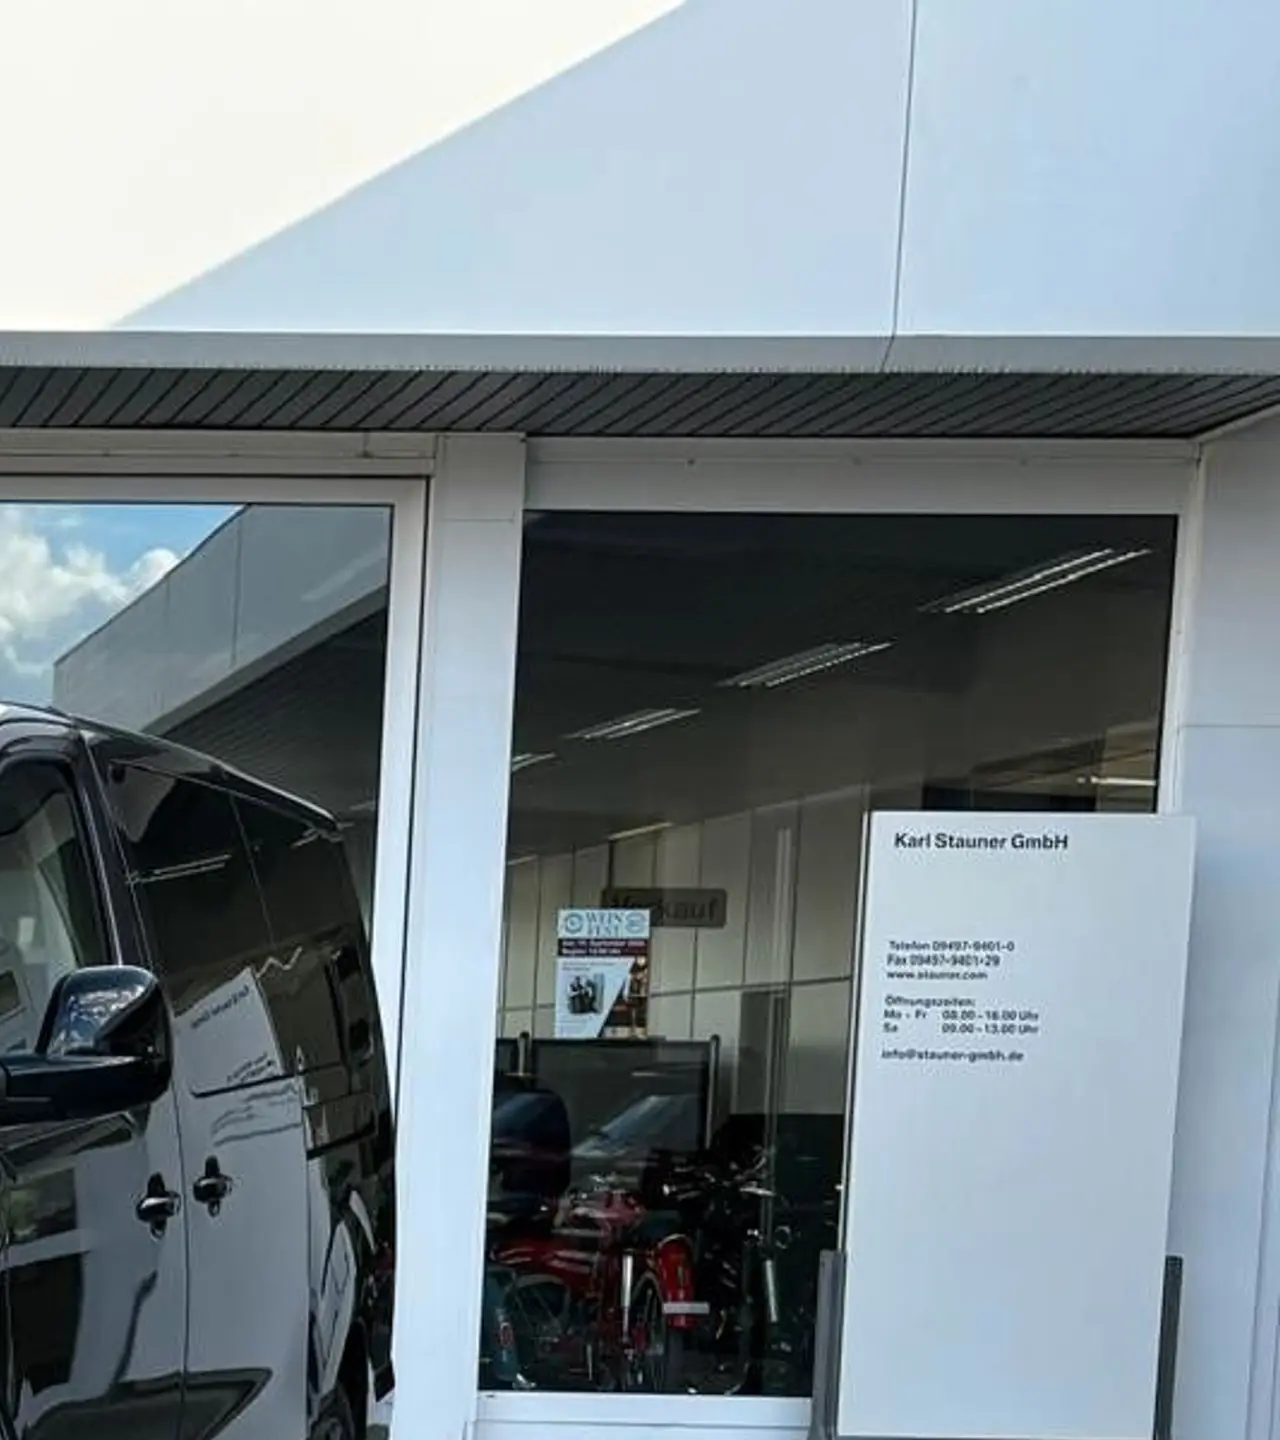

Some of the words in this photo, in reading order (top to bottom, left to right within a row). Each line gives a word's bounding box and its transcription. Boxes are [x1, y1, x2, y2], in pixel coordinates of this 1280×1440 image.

[894, 832, 931, 849] Karl
[934, 832, 1007, 849] Stauner
[1011, 833, 1068, 849] GmbH
[889, 940, 930, 951] Telefon
[886, 954, 907, 965] Fax
[886, 969, 988, 980] www.stauner.com
[885, 993, 976, 1008] Öffnungszeiten:
[883, 1009, 902, 1019] Mo
[915, 1009, 927, 1019] Fr
[1019, 1010, 1039, 1020] Uhr
[882, 1023, 898, 1033] Sa
[1018, 1023, 1039, 1034] Uhr
[881, 1048, 1024, 1062] info@stauner-gmbh.de
